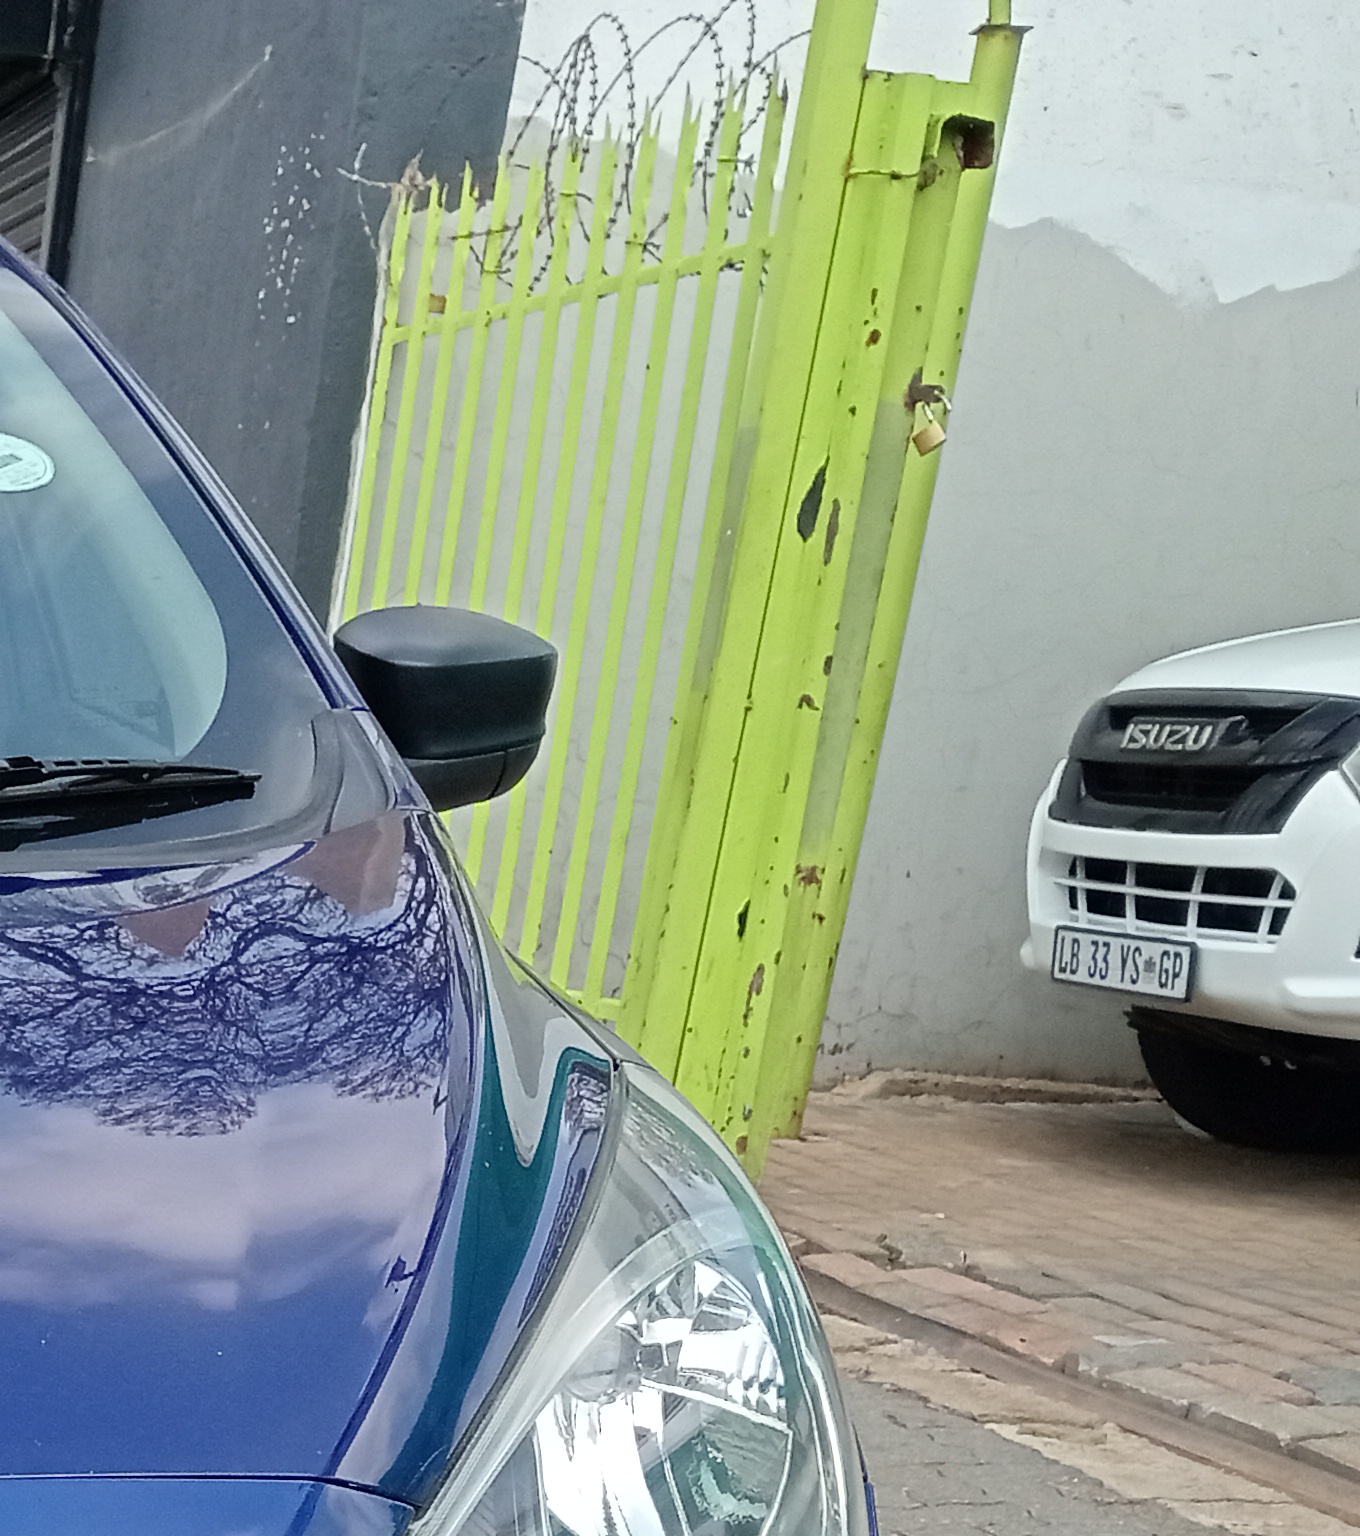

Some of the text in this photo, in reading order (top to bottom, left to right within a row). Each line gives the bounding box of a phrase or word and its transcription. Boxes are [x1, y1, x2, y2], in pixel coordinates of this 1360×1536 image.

[1120, 723, 1213, 751] ISUZU
[1058, 935, 1184, 991] LB 33 YS GP
